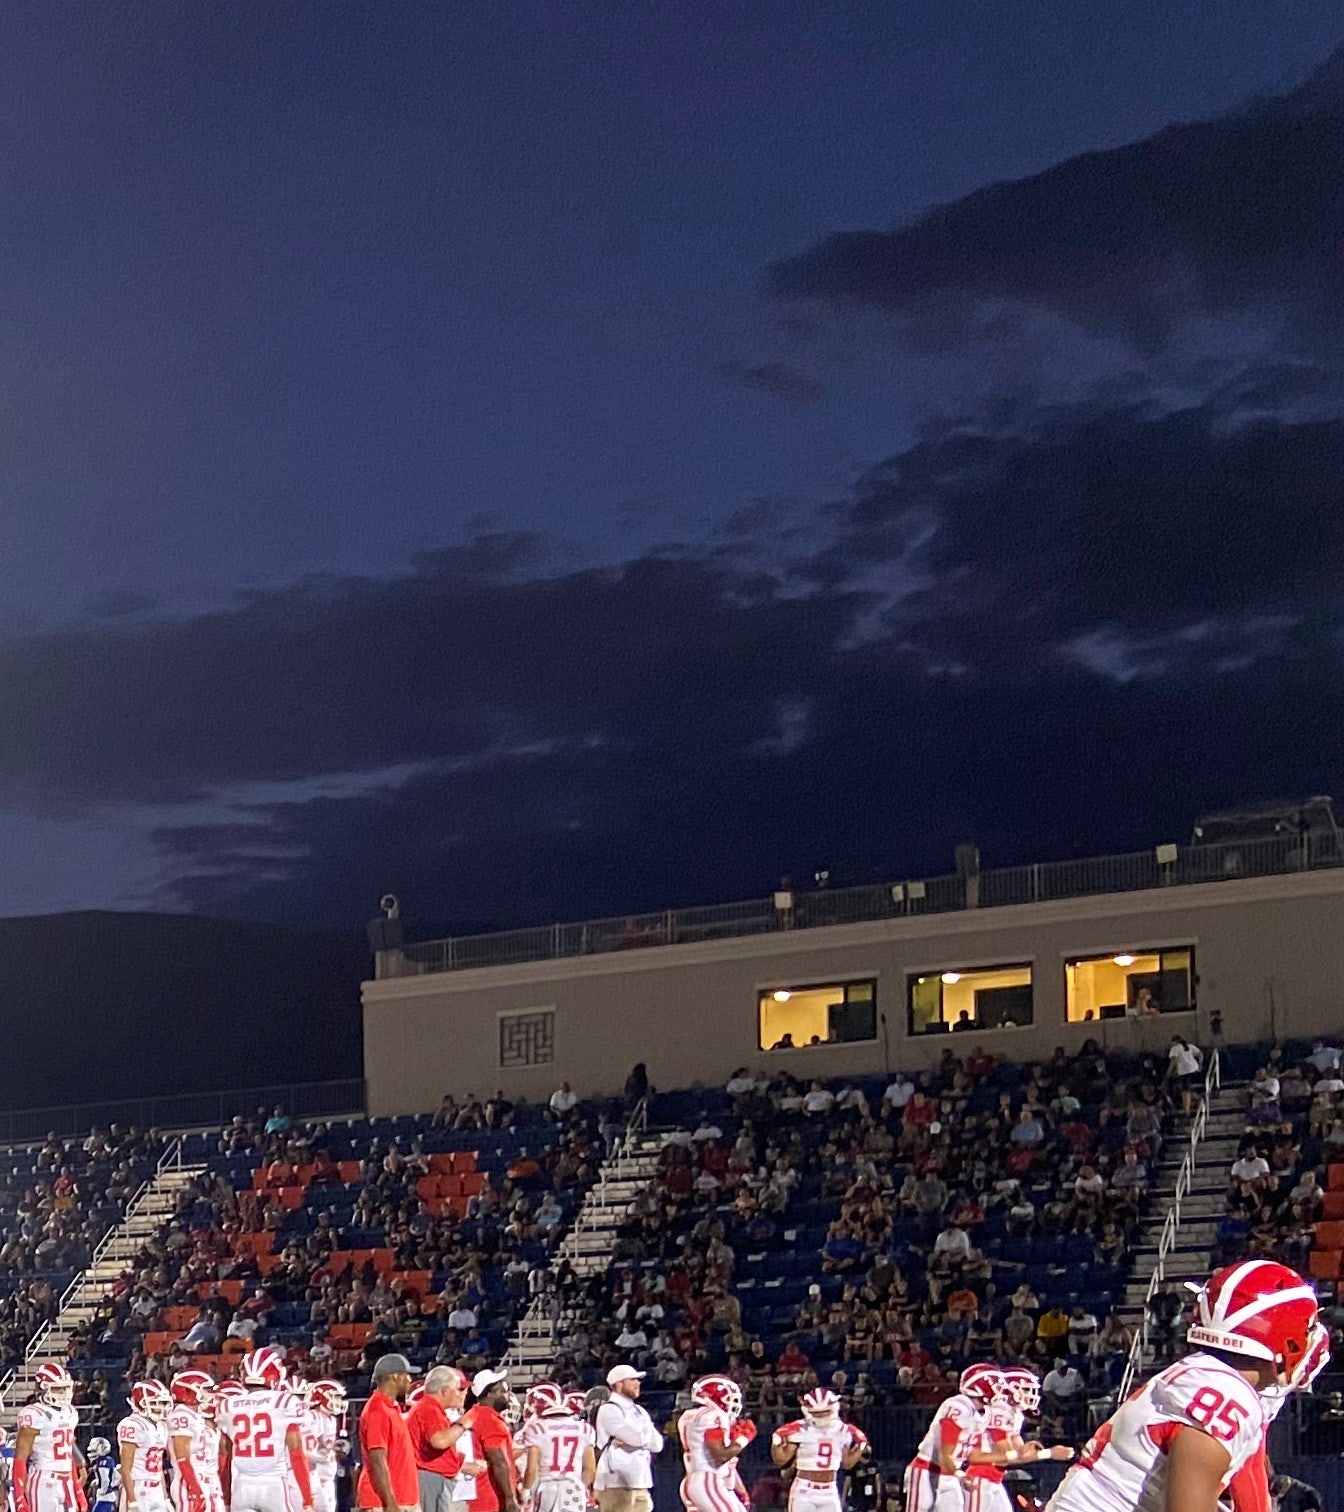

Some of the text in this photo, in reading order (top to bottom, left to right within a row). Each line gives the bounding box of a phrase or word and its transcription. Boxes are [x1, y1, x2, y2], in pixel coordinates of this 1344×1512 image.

[1222, 1337, 1244, 1349] DEI
[172, 1416, 189, 1430] 39
[1185, 1386, 1250, 1441] 85
[119, 1425, 135, 1439] 82
[232, 1412, 275, 1458] 22
[549, 1435, 580, 1473] 17
[816, 1442, 833, 1469] 9
